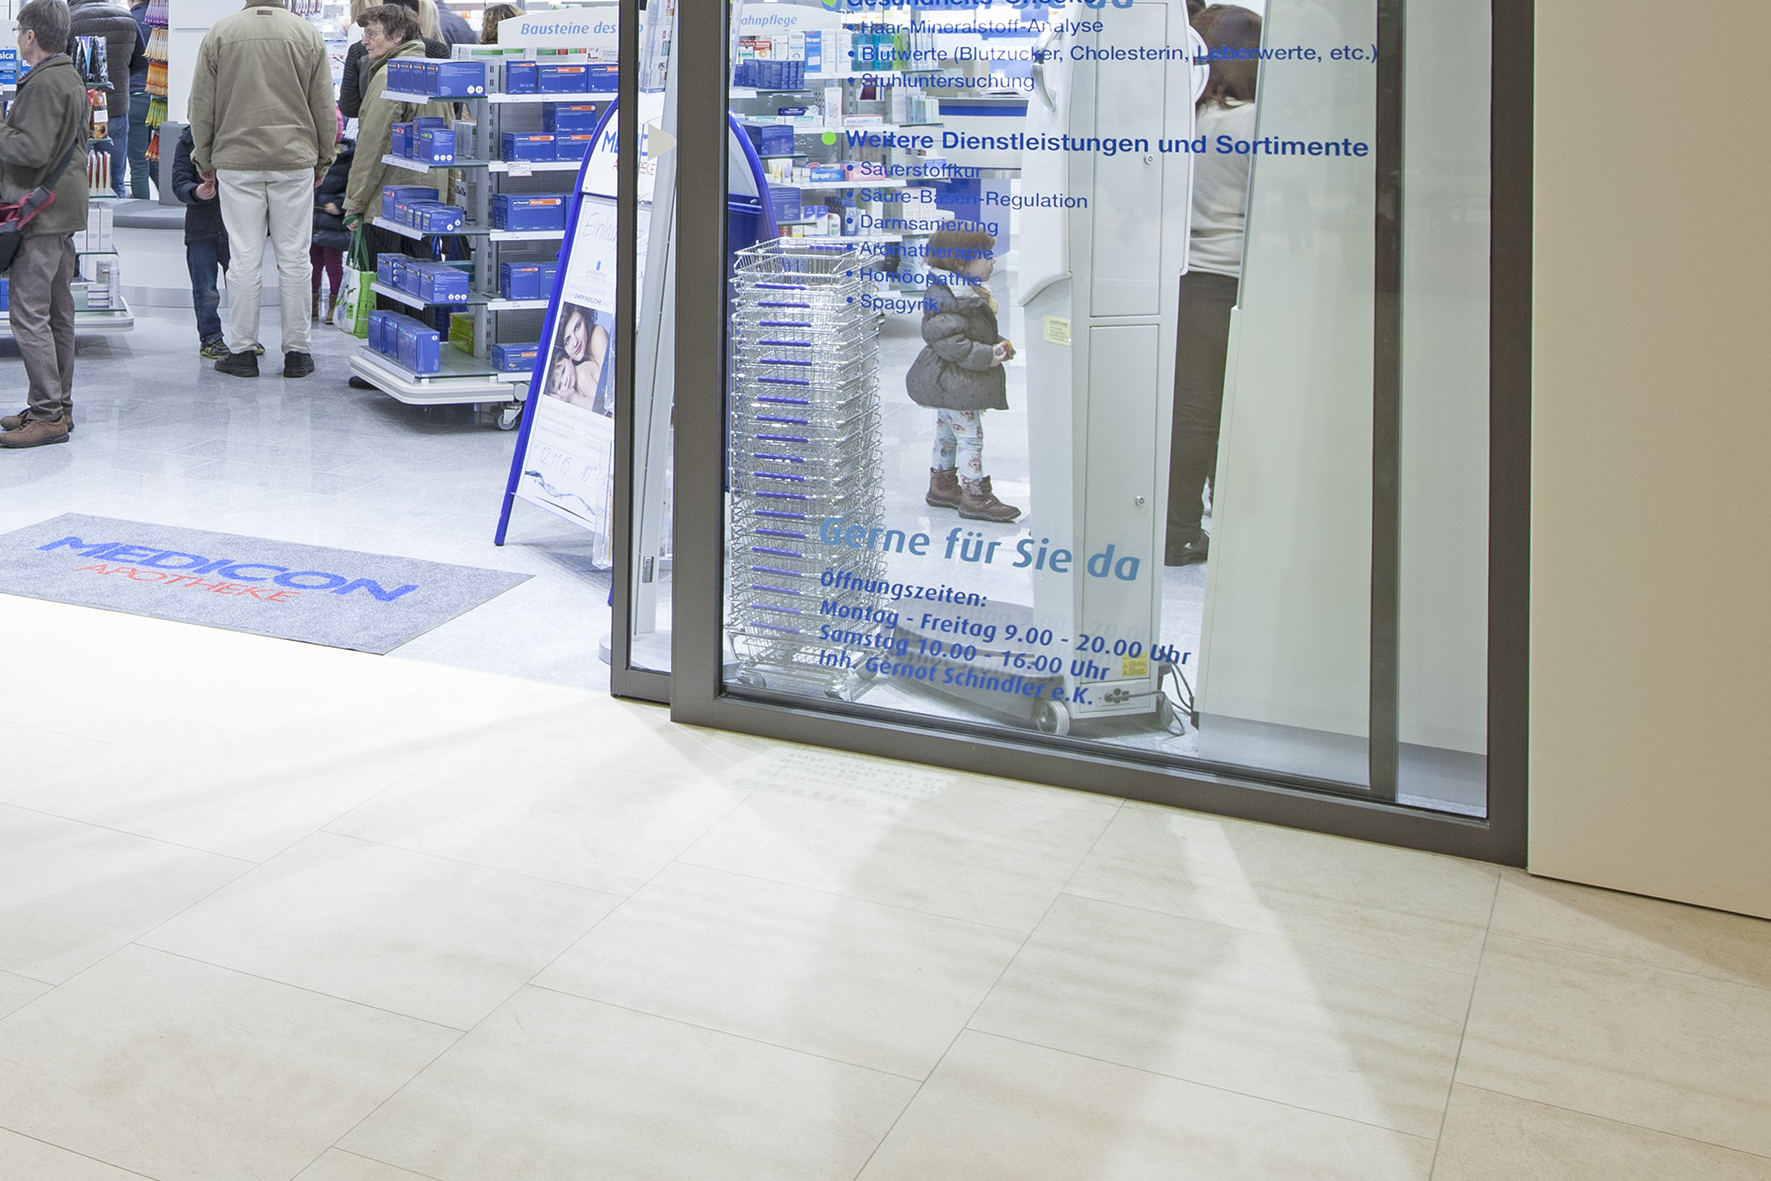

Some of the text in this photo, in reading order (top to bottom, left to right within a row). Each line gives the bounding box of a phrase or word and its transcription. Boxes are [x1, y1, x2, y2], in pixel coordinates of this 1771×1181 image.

[520, 21, 617, 35] Bausteine des
[740, 15, 798, 27] ahnpflege
[861, 19, 1104, 36] Haar-Mineralstoff-Analyse
[861, 43, 1378, 64] Blutwerte (Blutzucker, Cholesterin, Leberwerte, etc.)
[861, 73, 1035, 91] Stuhluntersuchung
[845, 130, 1369, 156] Weitere Dienstleistungen und Sortimente
[860, 161, 981, 179] Sauerstoffkur
[860, 187, 1088, 211] Säure-Basen-Regulation
[860, 214, 999, 237] Darmsanierung
[859, 241, 994, 264] Aromatherapie
[860, 268, 983, 288] Homöopathie
[860, 293, 939, 313] Spagyrik
[819, 517, 1141, 582] Gerne für Sie da
[35, 535, 418, 603] MEDICON
[74, 563, 301, 603] APOTHEKE
[819, 567, 988, 607] Öffnungszeiten:
[819, 599, 900, 630] Montag
[920, 613, 997, 643] Freitag
[1005, 624, 1053, 646] 9.00
[1075, 634, 1142, 658] 20.00
[1150, 643, 1192, 666] Uhr
[819, 623, 909, 658] Samstag
[917, 639, 977, 662] 10.00
[1001, 650, 1062, 674] 16.00
[1070, 659, 1110, 681] Uhr
[819, 648, 1094, 706] Inh. Gernot Schindler e.K.
